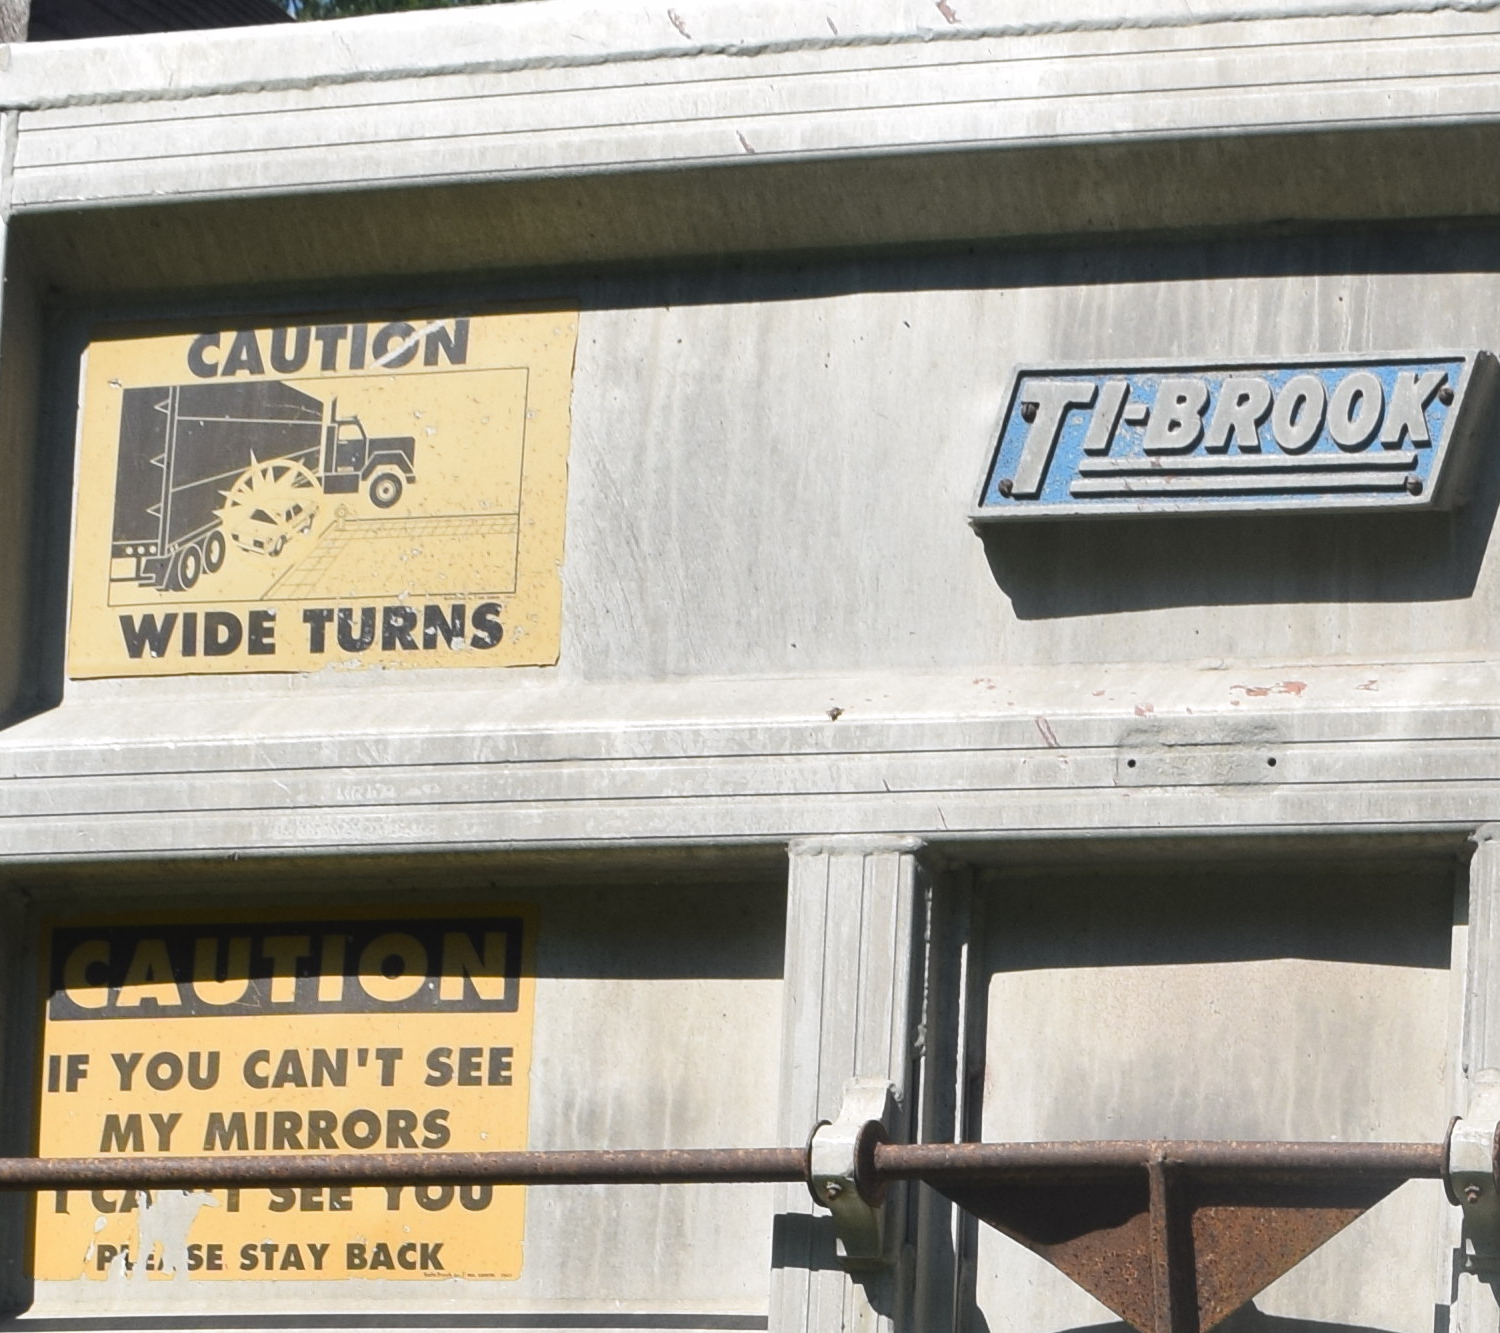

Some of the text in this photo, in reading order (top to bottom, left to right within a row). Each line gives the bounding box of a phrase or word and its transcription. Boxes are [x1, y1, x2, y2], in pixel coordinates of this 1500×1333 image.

[186, 317, 471, 378] CAUTION
[1010, 370, 1448, 495] TI-BROOK
[118, 602, 505, 659] WIDE TURNS
[62, 932, 506, 1009] CAUTION
[46, 1046, 514, 1093] IF YOU CAN'T SEE
[99, 1108, 452, 1152] MY MIRRORS
[268, 1188, 353, 1213] SEE
[384, 1185, 494, 1212] YOU
[239, 1242, 331, 1271] STAY
[345, 1241, 445, 1271] BACK
